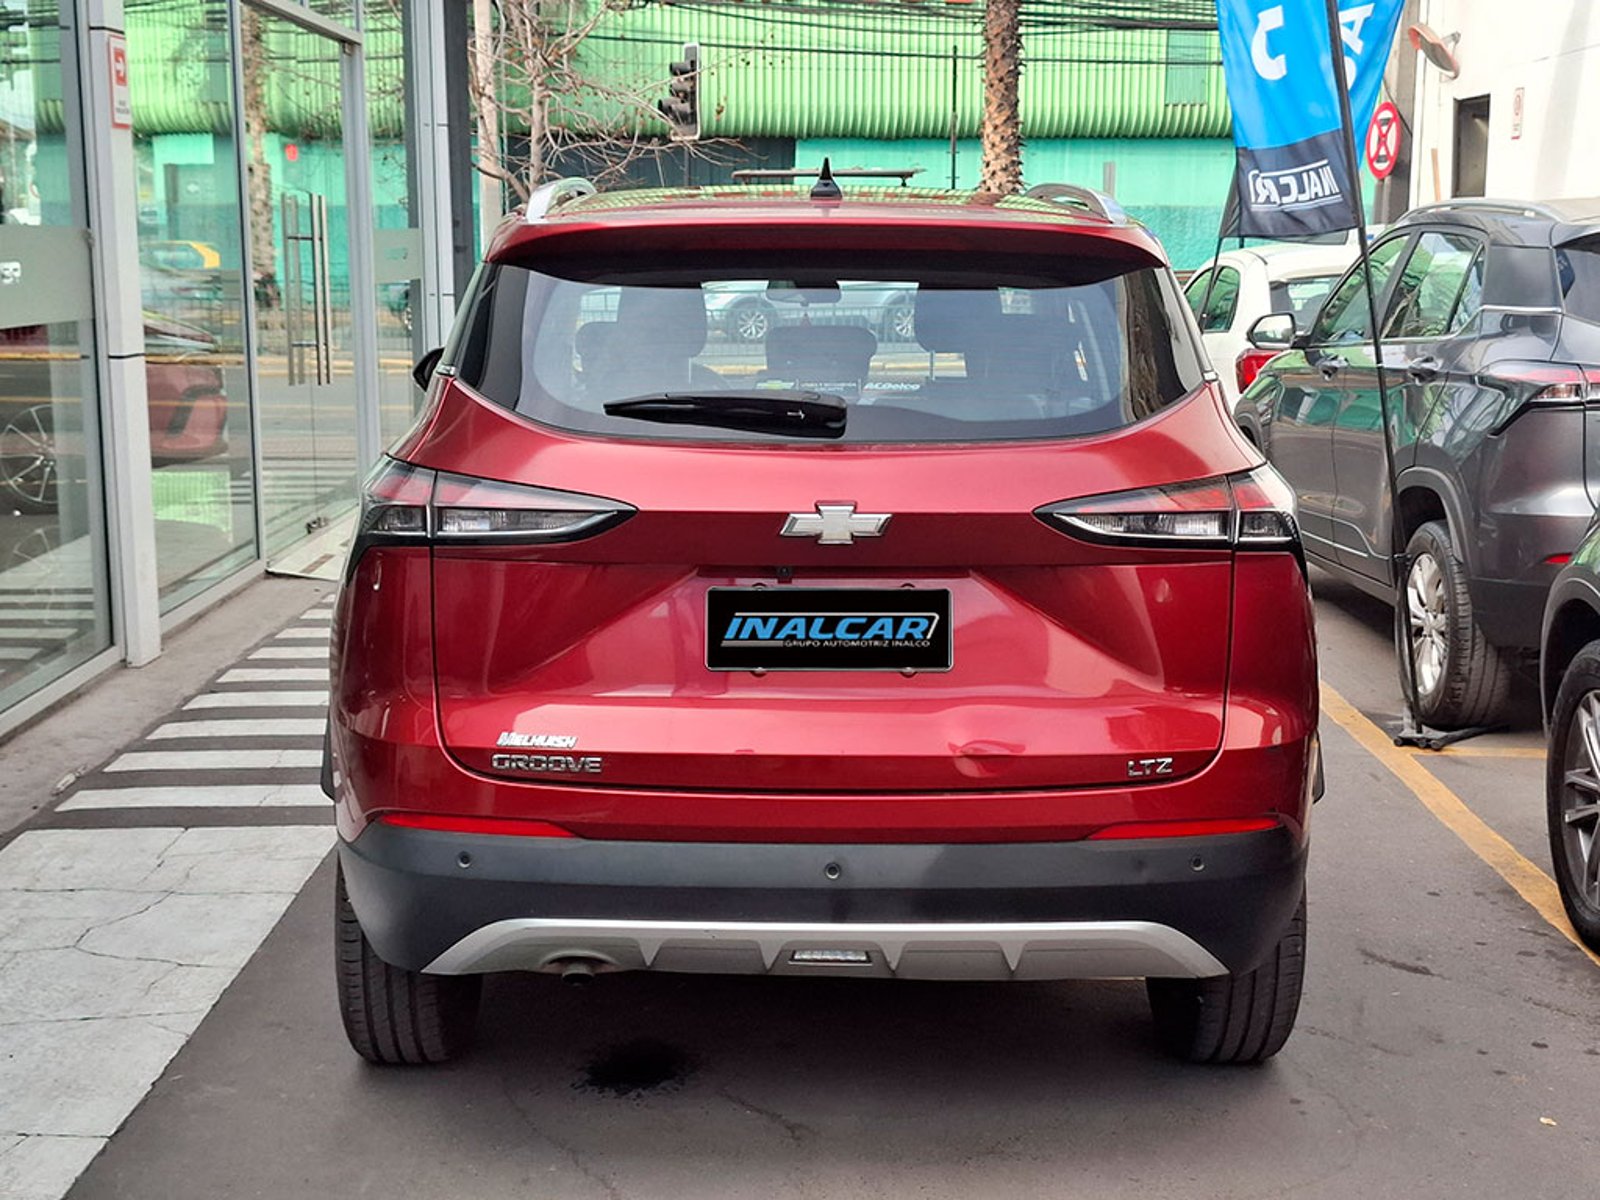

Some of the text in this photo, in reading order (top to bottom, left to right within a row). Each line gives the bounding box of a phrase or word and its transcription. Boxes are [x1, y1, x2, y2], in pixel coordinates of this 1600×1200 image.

[863, 381, 921, 391] ACDelco
[723, 616, 930, 640] INALCAR
[784, 639, 931, 648] GRUPO AUTOMOTRIZ INALCO
[492, 754, 603, 773] GROOVE
[1127, 757, 1173, 777] LTZ
